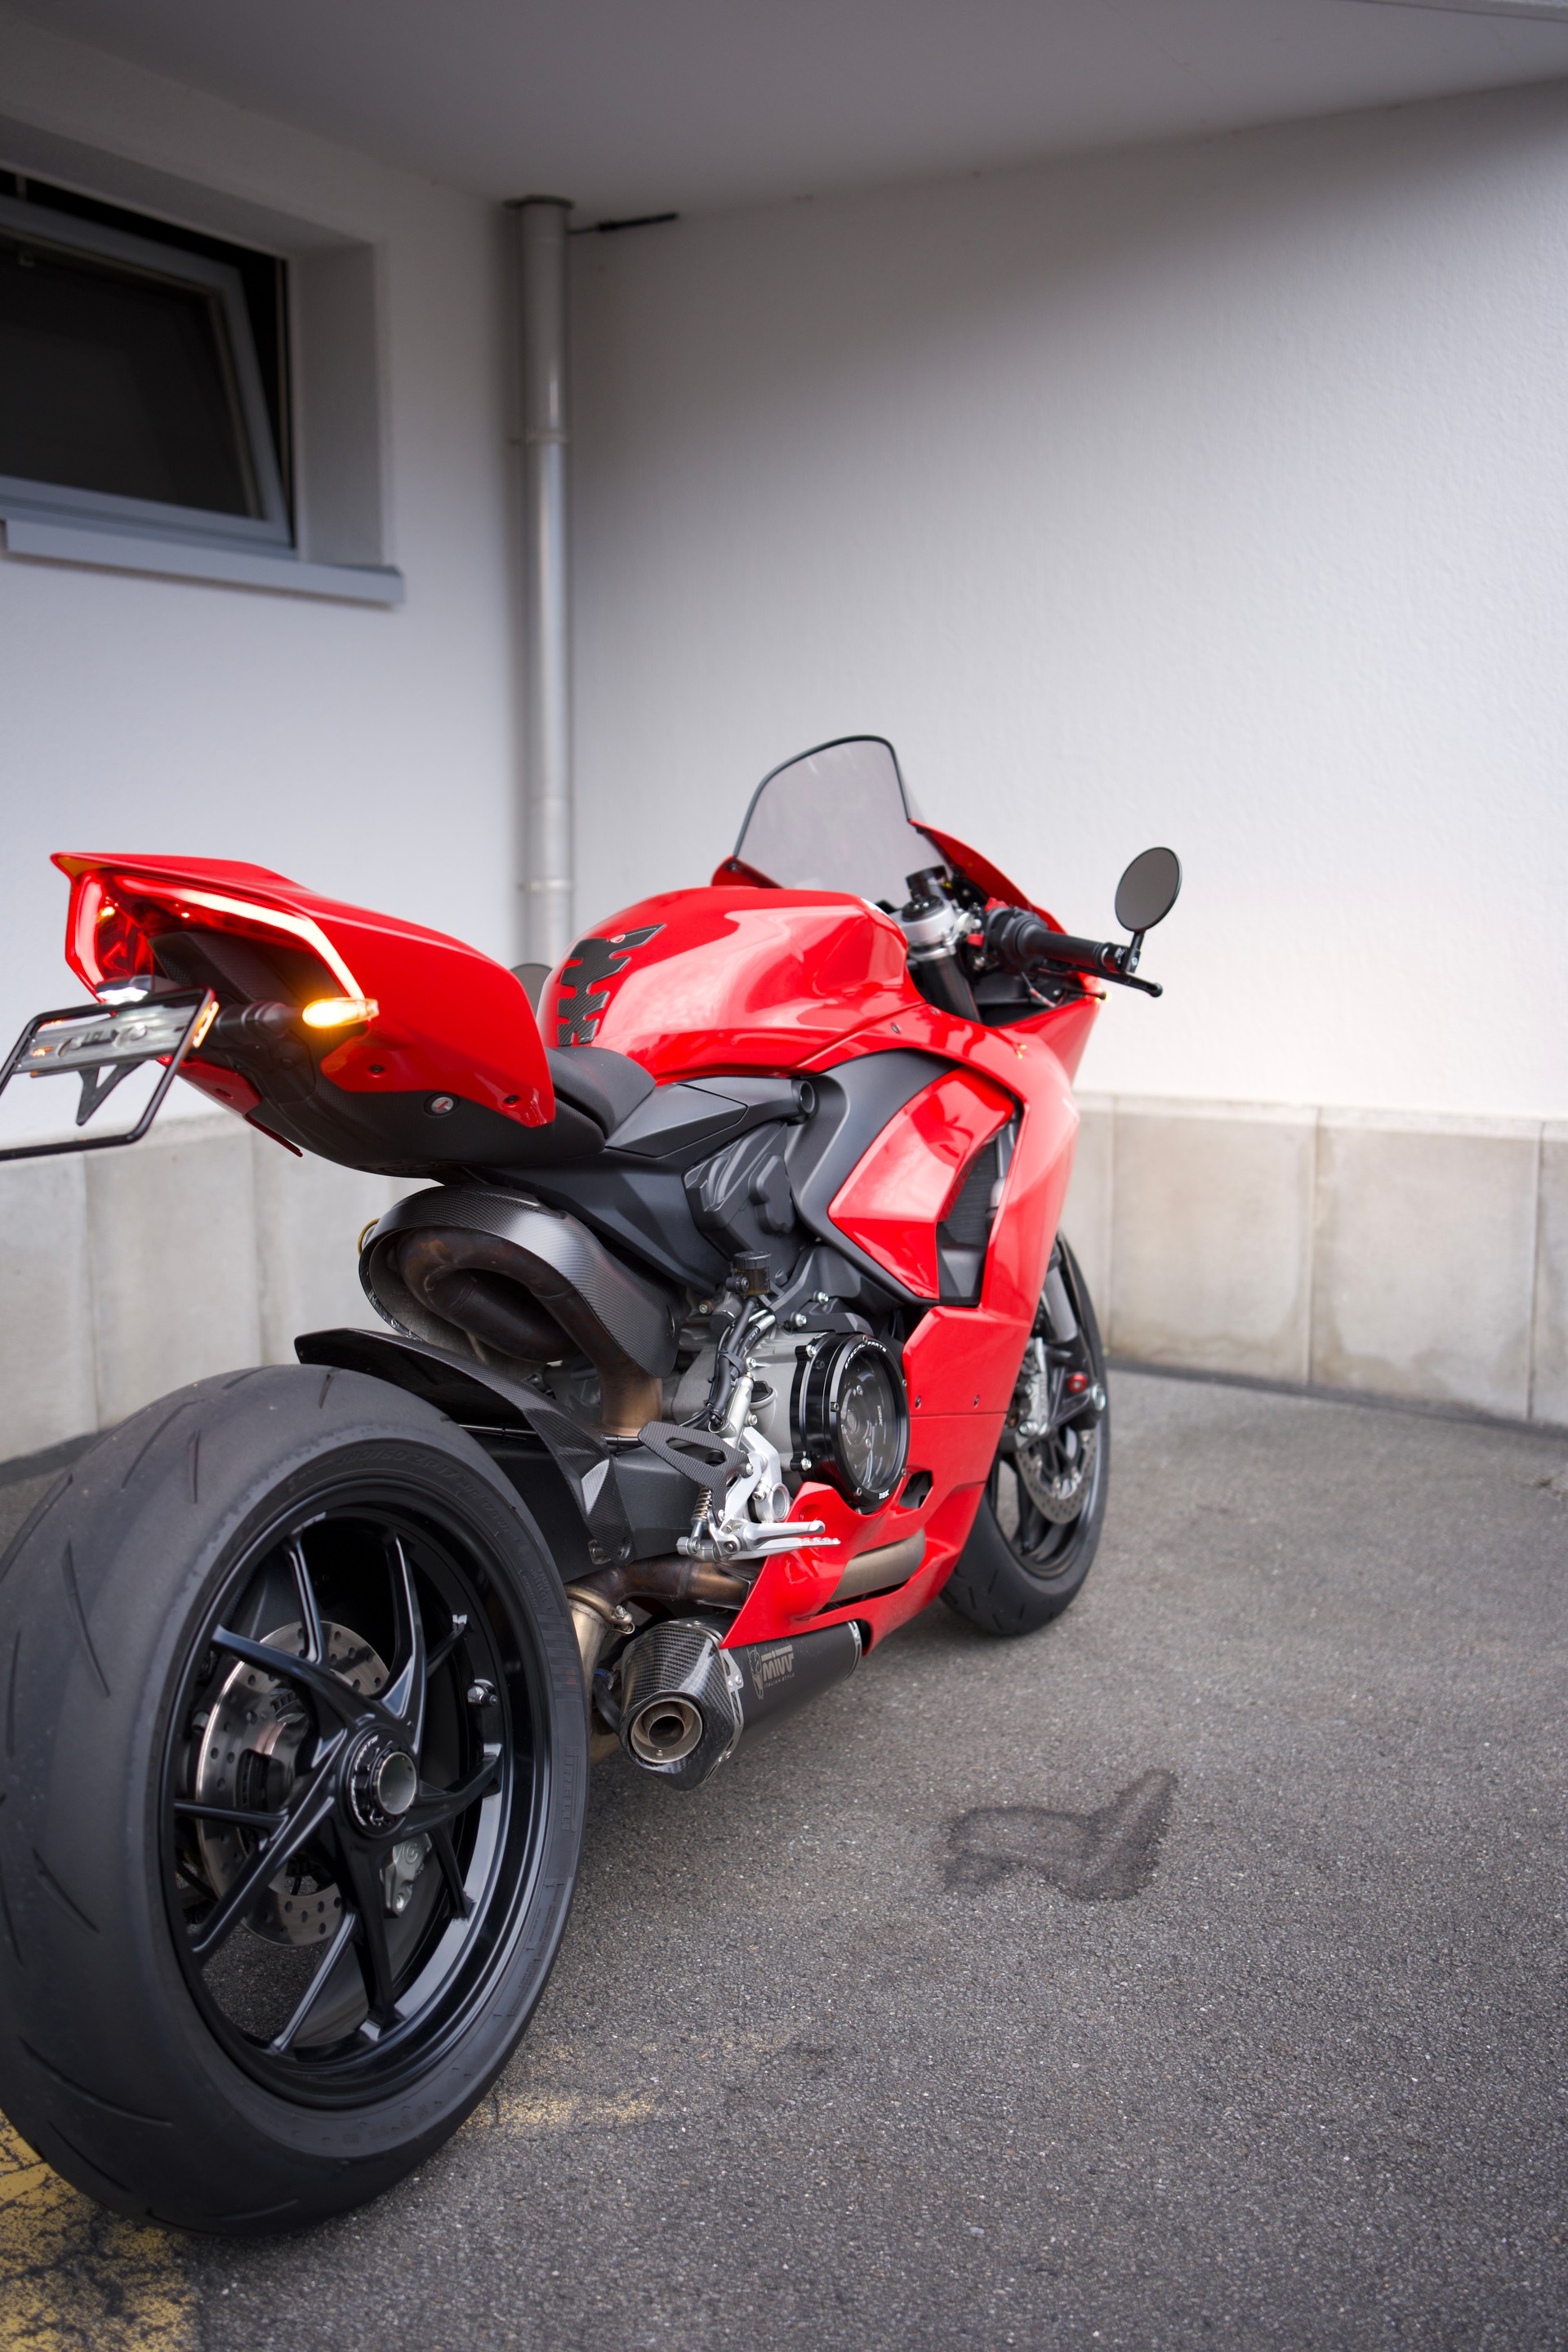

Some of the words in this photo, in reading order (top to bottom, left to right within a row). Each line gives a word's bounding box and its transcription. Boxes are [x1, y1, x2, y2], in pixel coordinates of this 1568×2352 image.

[844, 1343, 866, 1370] SPECIAL
[866, 1340, 888, 1353] PARTS
[764, 1678, 782, 1689] ITALIAN
[782, 1673, 795, 1682] STYLE
[560, 1744, 583, 1833] PIRELLI
